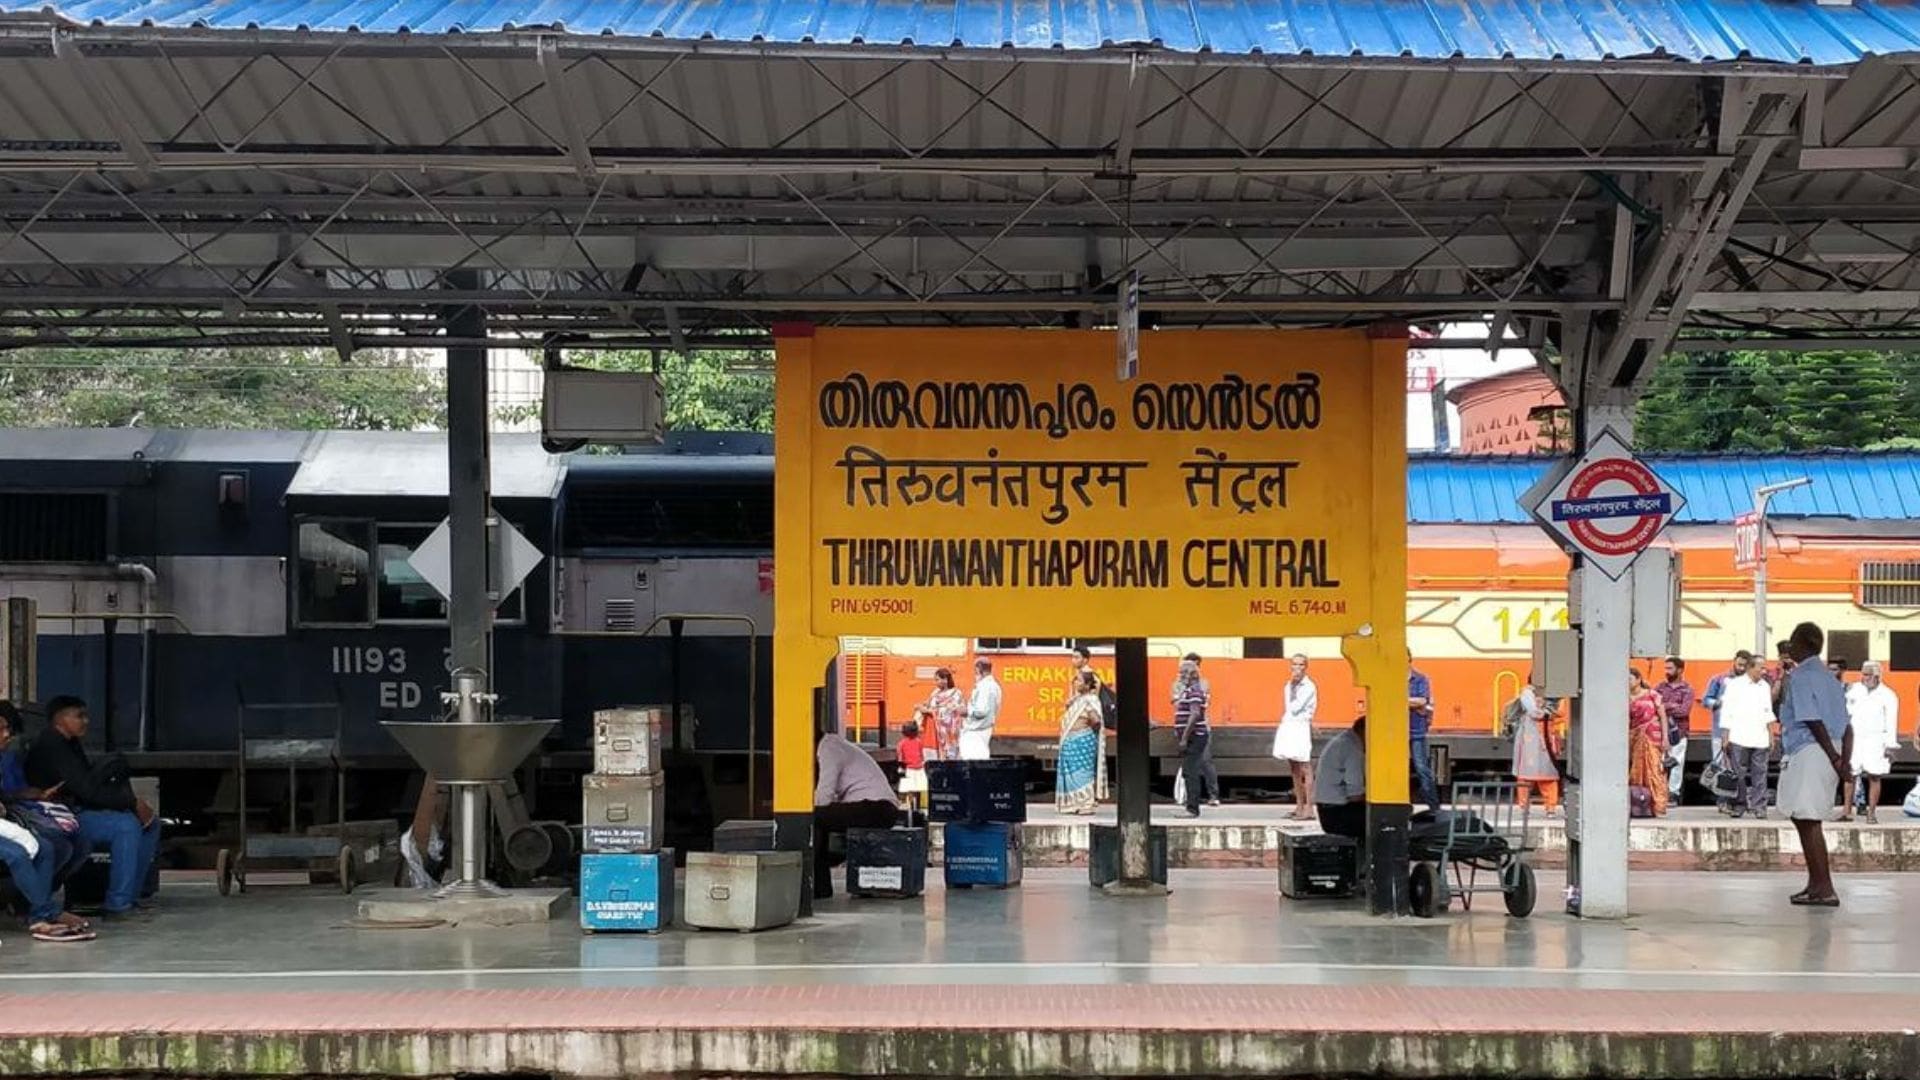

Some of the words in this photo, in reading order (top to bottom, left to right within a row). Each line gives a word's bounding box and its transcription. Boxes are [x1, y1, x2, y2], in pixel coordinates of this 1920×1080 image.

[823, 538, 1168, 587] THIRUVANANTHAPURAM
[1183, 539, 1339, 588] CENTRAL
[332, 646, 407, 673] 11193
[380, 681, 422, 708] ED
[1039, 687, 1064, 703] SR
